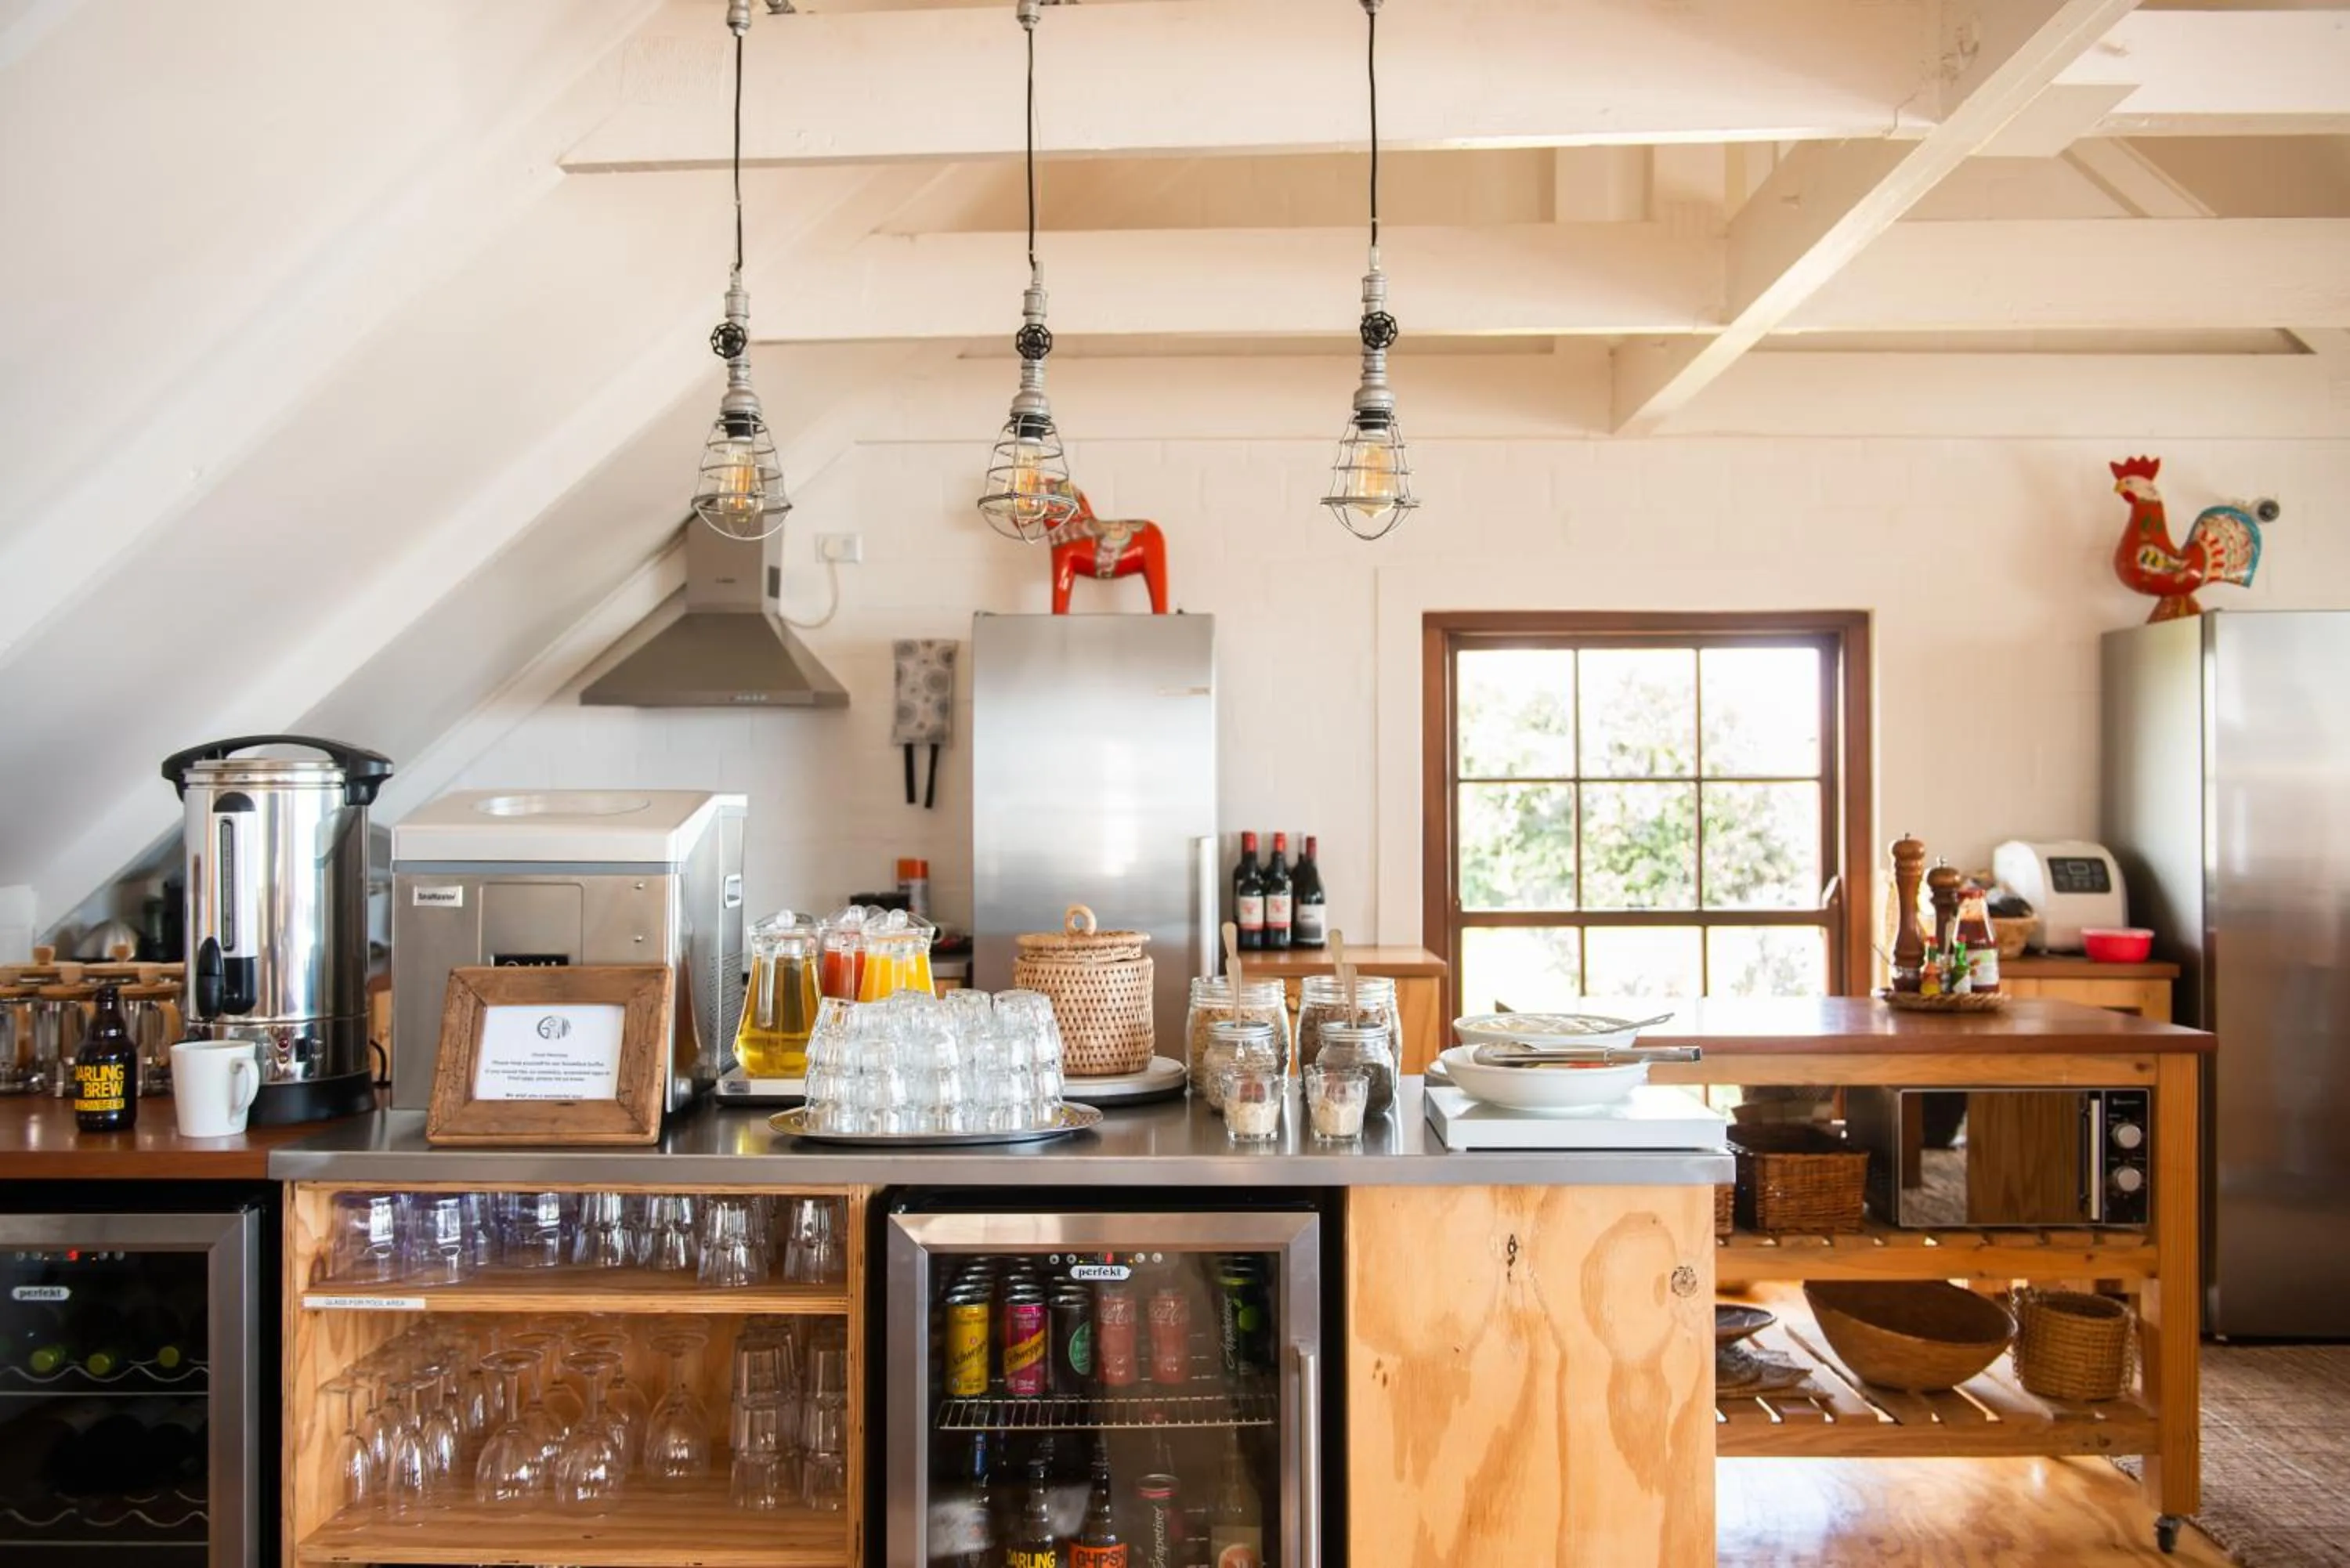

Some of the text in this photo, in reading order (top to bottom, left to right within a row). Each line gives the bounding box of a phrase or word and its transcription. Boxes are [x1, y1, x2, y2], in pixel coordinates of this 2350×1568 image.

[84, 1081, 124, 1098] BREW
[1078, 1266, 1122, 1279] perfekt
[19, 1288, 62, 1299] perfekt
[1007, 1549, 1056, 1568] DARLING
